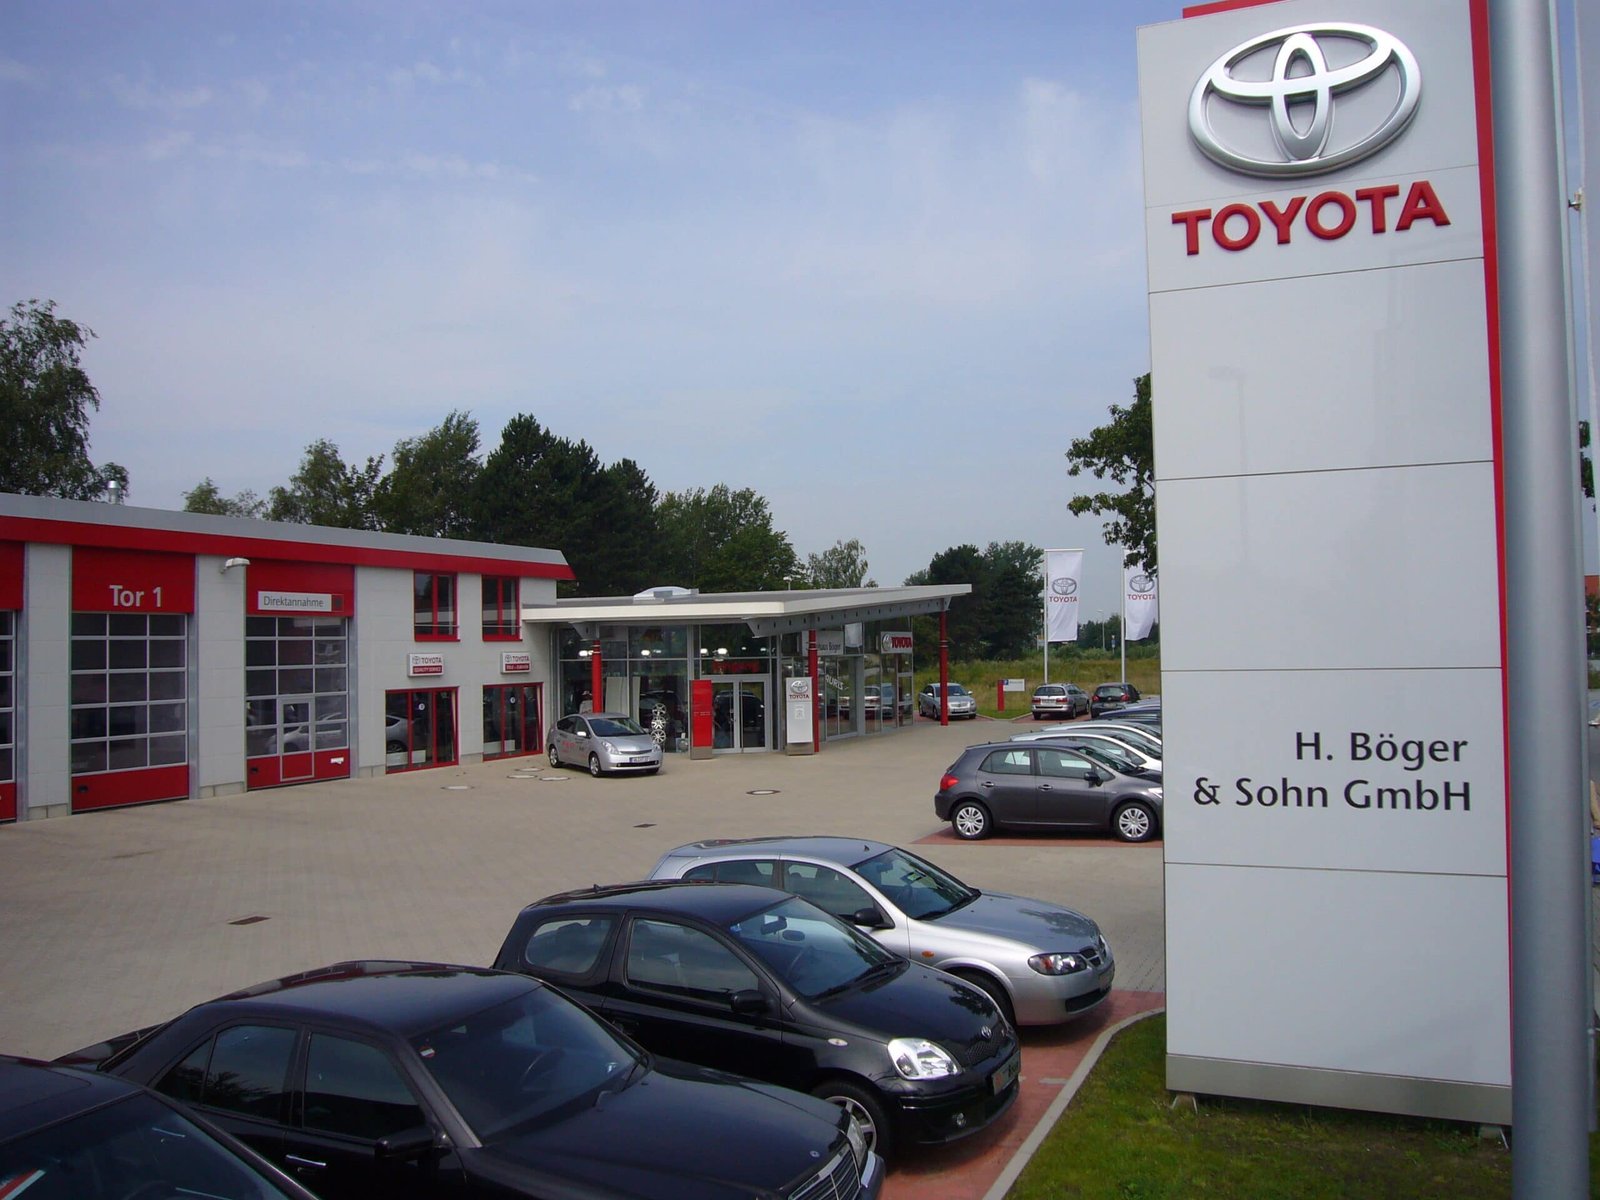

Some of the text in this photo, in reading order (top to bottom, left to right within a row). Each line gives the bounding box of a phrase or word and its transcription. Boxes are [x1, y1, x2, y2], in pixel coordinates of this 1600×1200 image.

[1171, 180, 1451, 256] TOYOTA
[109, 584, 162, 608] Tor 1
[263, 595, 324, 608] Direktannahme
[891, 636, 912, 648] TOYOTA
[421, 656, 442, 664] TOYOTA
[1296, 732, 1468, 771] H. Böger
[1193, 777, 1471, 811] & Sohn GmbH
